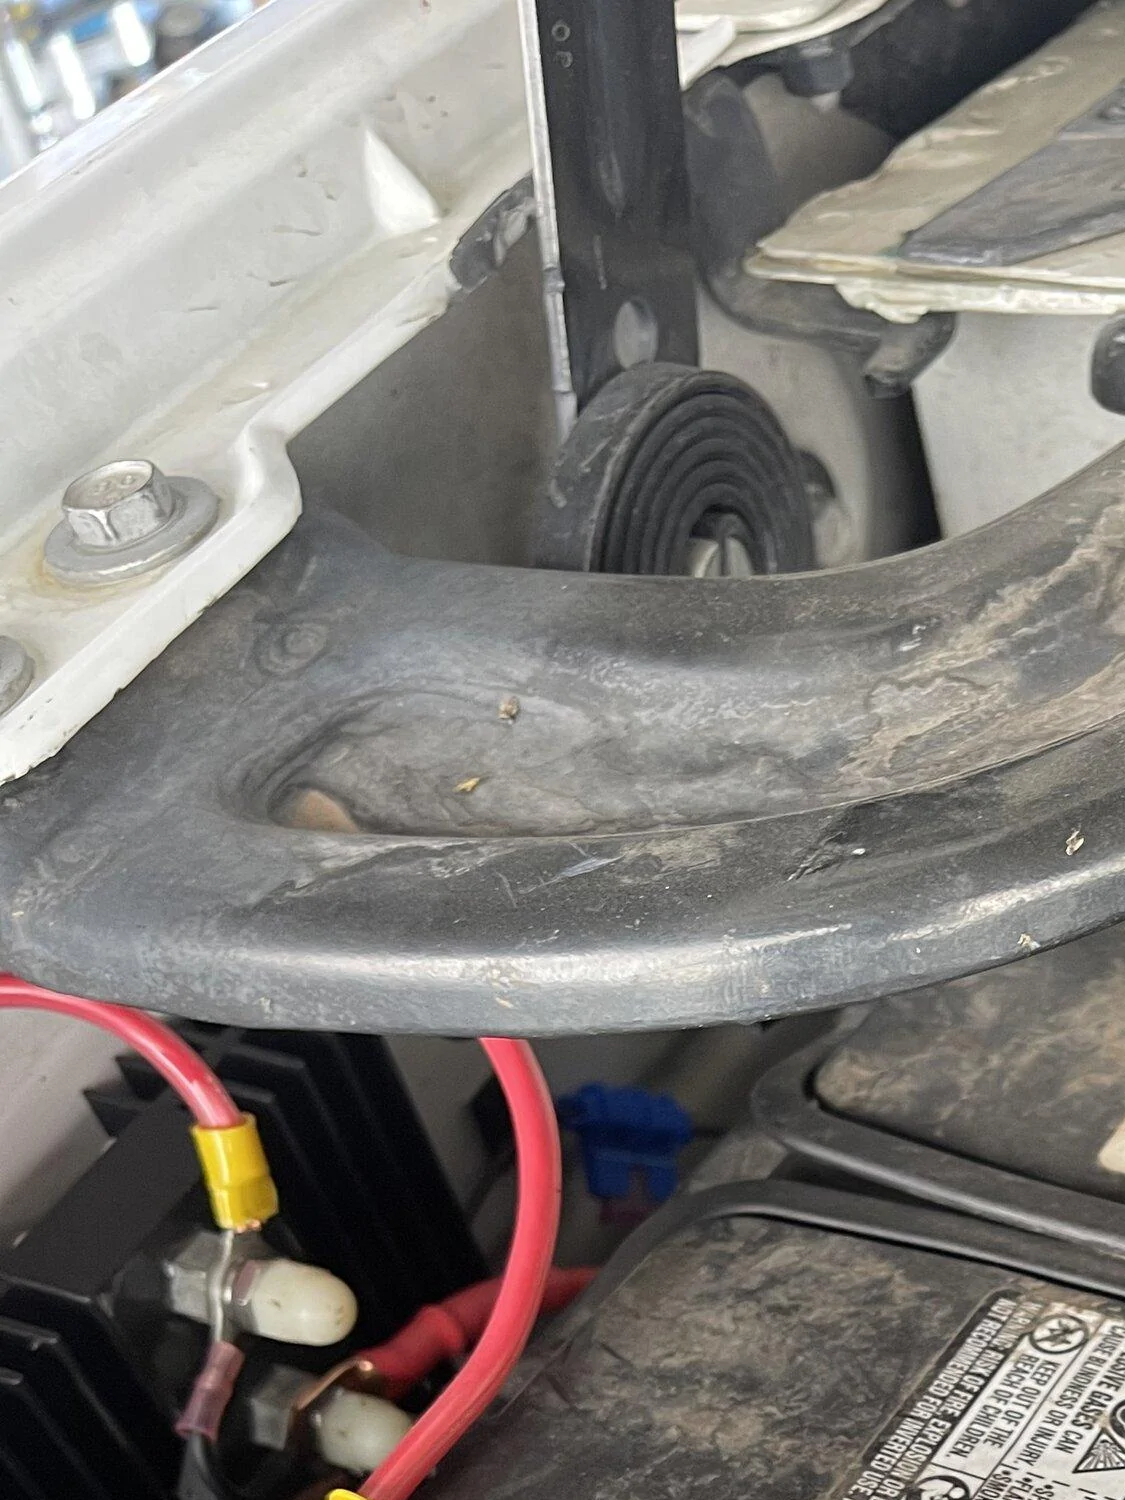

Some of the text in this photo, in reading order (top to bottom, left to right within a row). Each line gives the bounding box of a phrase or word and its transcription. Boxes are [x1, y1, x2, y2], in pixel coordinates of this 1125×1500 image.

[984, 1297, 1017, 1322] NOT
[926, 1318, 1001, 1397] RECOMMENDED
[969, 1349, 1003, 1377] RISK
[957, 1374, 984, 1392] OF
[1053, 1354, 1107, 1409] BLINDNESS
[909, 1394, 942, 1419] FOR
[933, 1389, 973, 1419] FIRE,
[945, 1353, 1039, 1460] REACH OF CHILDREN.
[982, 1359, 1060, 1448] KEEP OUT OF THE
[1042, 1409, 1067, 1426] OR
[1069, 1389, 1113, 1430] GASES
[869, 1418, 924, 1471] INVERTED
[889, 1418, 952, 1479] EXPLOSION
[1013, 1425, 1056, 1467] INJURY.
[1053, 1429, 1084, 1454] CAN
[849, 1470, 885, 1498] USE.
[875, 1478, 905, 1497] OR
